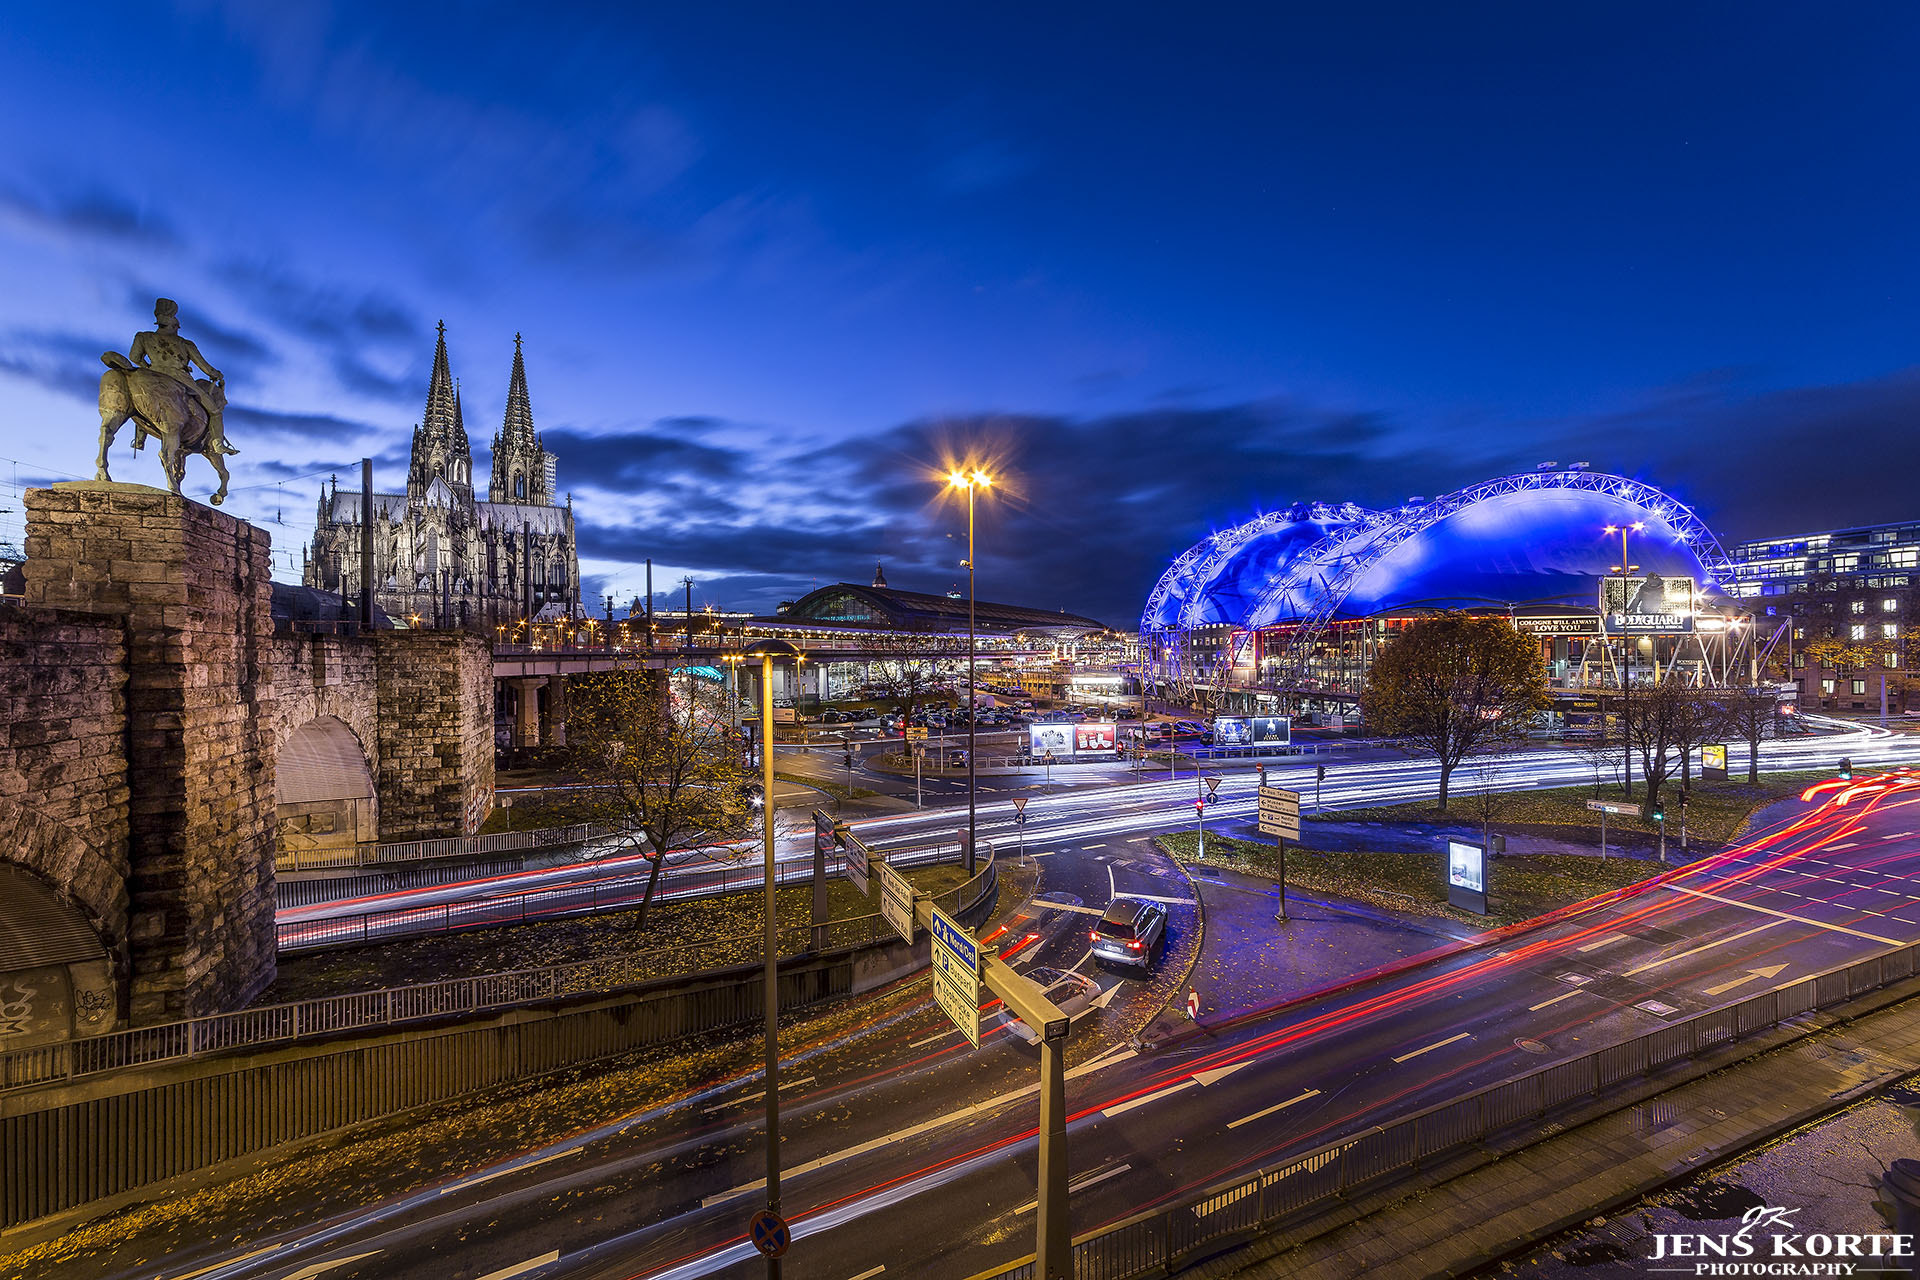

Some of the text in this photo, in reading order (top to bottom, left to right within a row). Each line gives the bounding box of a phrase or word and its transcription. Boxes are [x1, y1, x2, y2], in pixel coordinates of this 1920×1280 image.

[1614, 614, 1684, 625] BODYGUARD
[1277, 791, 1296, 799] Terminal
[949, 931, 975, 964] Nord/Ost
[943, 955, 974, 995] P Buspark
[942, 981, 971, 1021] Zoobrücke
[942, 994, 953, 1011] Zoo
[958, 1010, 974, 1037] Flora
